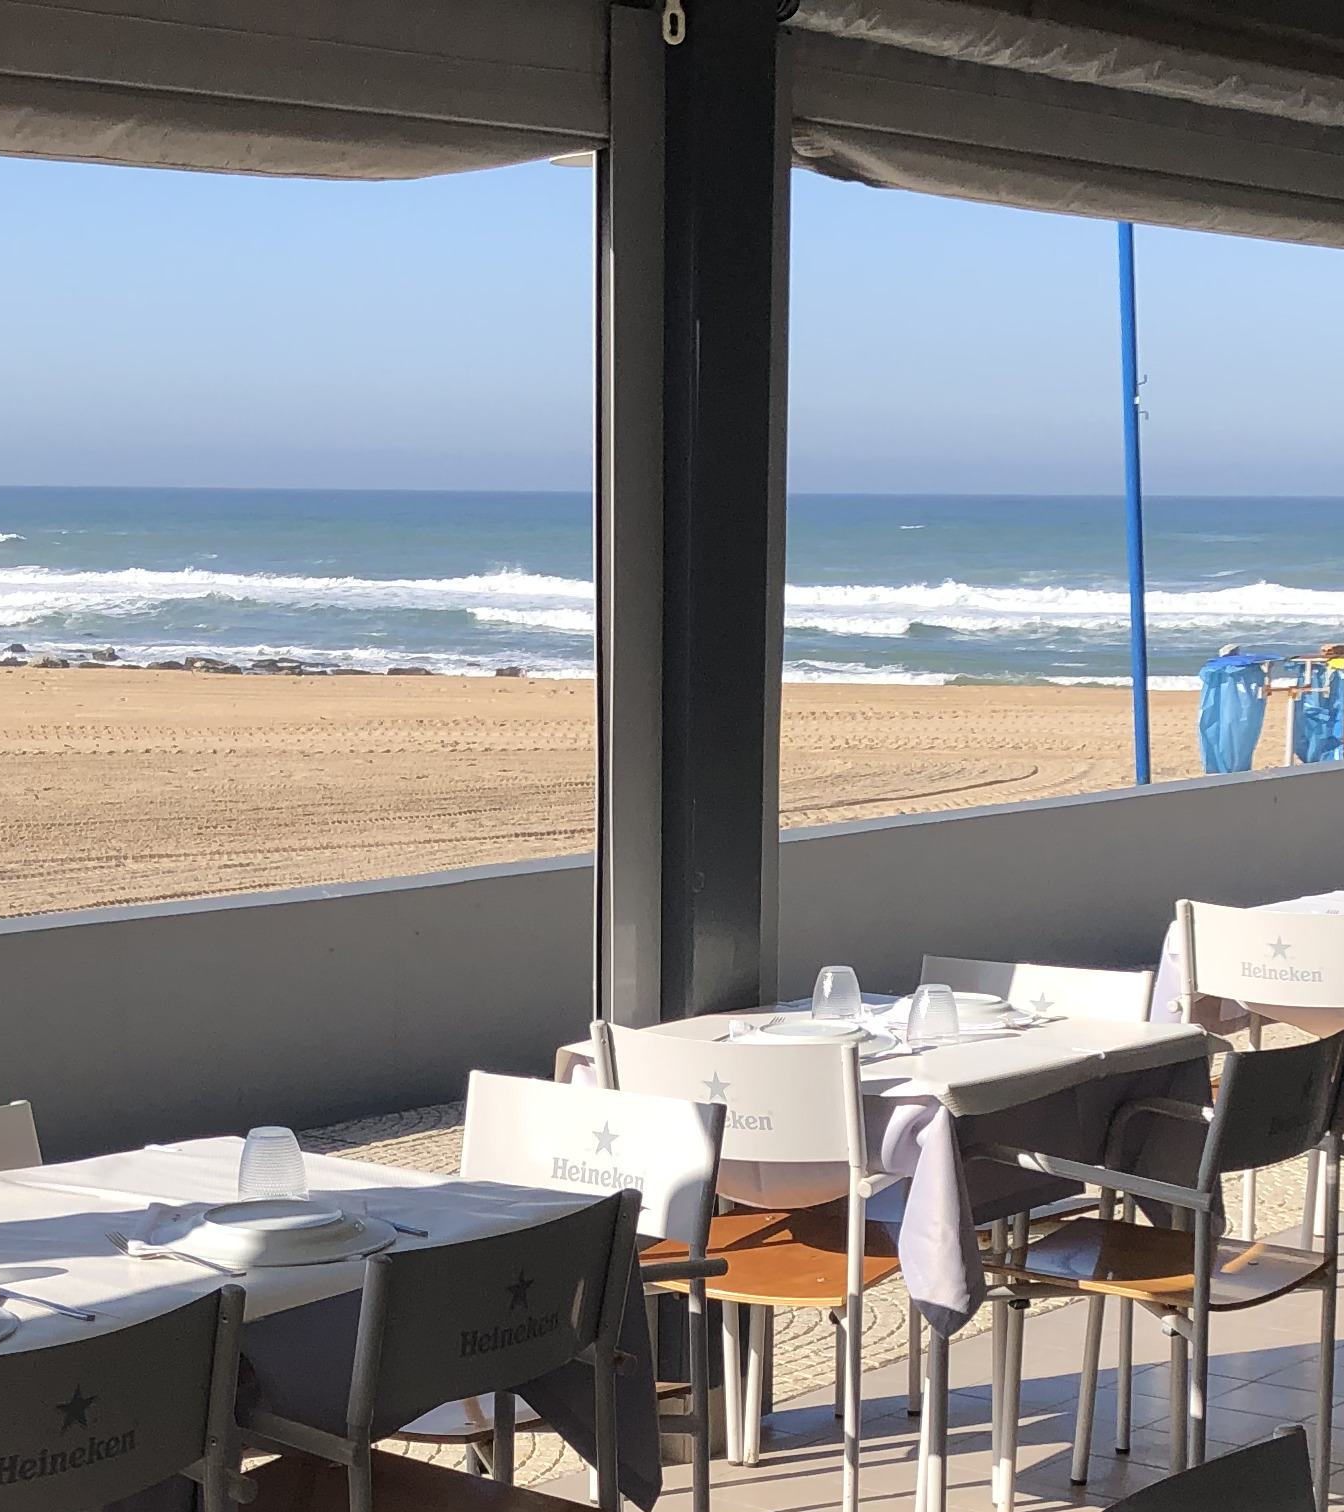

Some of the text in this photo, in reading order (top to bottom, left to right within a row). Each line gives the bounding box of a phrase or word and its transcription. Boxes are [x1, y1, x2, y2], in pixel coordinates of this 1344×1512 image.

[1240, 961, 1323, 983] Heineken
[551, 1156, 645, 1191] Heineken
[459, 1312, 560, 1358] Heineken
